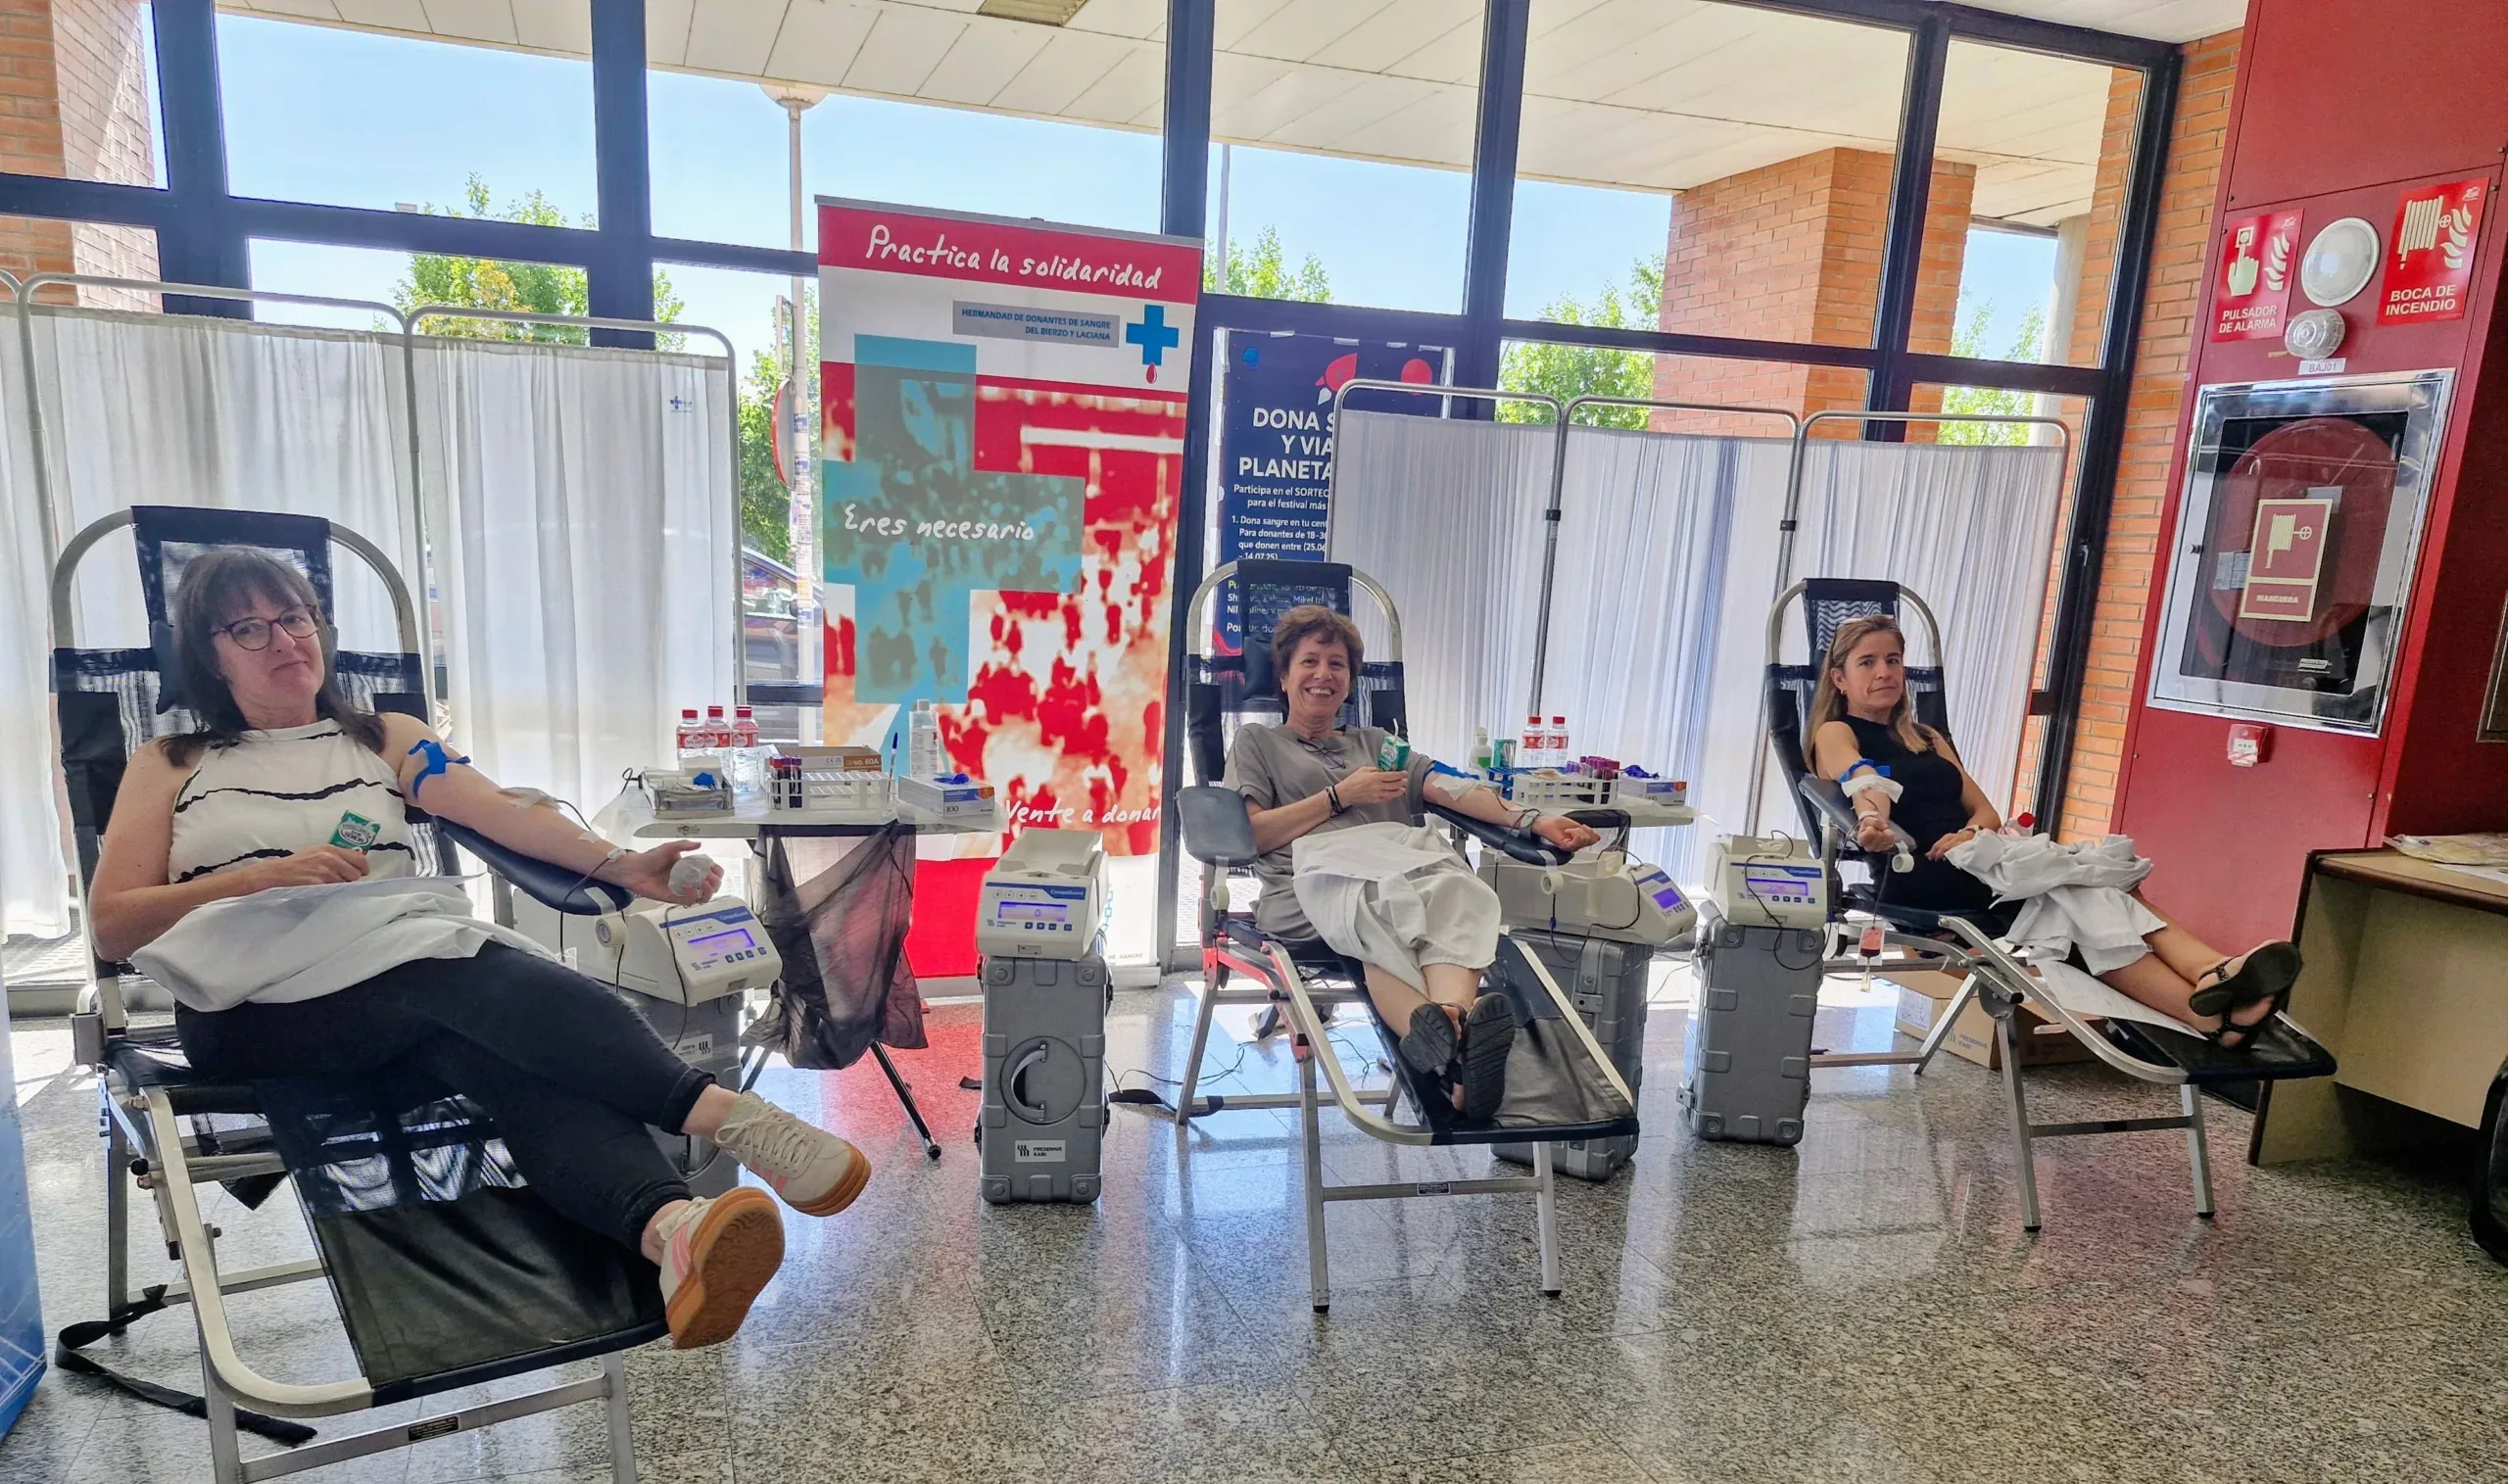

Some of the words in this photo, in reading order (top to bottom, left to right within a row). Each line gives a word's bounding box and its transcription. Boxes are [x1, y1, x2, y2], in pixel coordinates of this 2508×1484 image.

[865, 224, 980, 268] Practica
[989, 249, 1009, 273] la
[1019, 256, 1162, 290] solidaridad
[2390, 287, 2432, 303] BOCA
[2436, 284, 2457, 298] DE
[2222, 305, 2278, 320] PULSADOR
[2386, 299, 2456, 316] INCENDIO
[961, 309, 1013, 321] HERMANDAD
[1014, 313, 1024, 322] DE
[1026, 314, 1067, 326] DONANTES
[1068, 317, 1079, 326] DE
[1080, 319, 1111, 329] SANGRE
[2219, 322, 2234, 334] DE
[2234, 316, 2277, 332] ALARMA
[1040, 327, 1068, 337] BIERZO
[1076, 330, 1111, 341] LACIANA
[2308, 361, 2338, 373] BAJ01
[1252, 407, 1321, 431] DONA
[1280, 434, 1296, 455] Y
[1300, 436, 1333, 456] VIA
[1233, 484, 1271, 496] Participa
[1284, 487, 1293, 496] el
[1247, 499, 1267, 509] para
[1268, 499, 1277, 507] el
[1278, 499, 1308, 509] festival
[1309, 500, 1326, 510] más
[844, 503, 907, 536] Eres
[916, 519, 1035, 541] necesario
[1231, 515, 1239, 524] 1.
[1240, 515, 1261, 525] Dona
[1262, 518, 1288, 528] sangre
[1301, 518, 1310, 527] tu
[1238, 528, 1257, 537] Para
[1258, 529, 1293, 539] donantes
[1295, 530, 1306, 539] de
[1238, 542, 1253, 551] que
[1255, 541, 1279, 550] donen
[1005, 796, 1075, 824] Vente
[1082, 809, 1093, 823] a
[1101, 804, 1161, 824] donar
